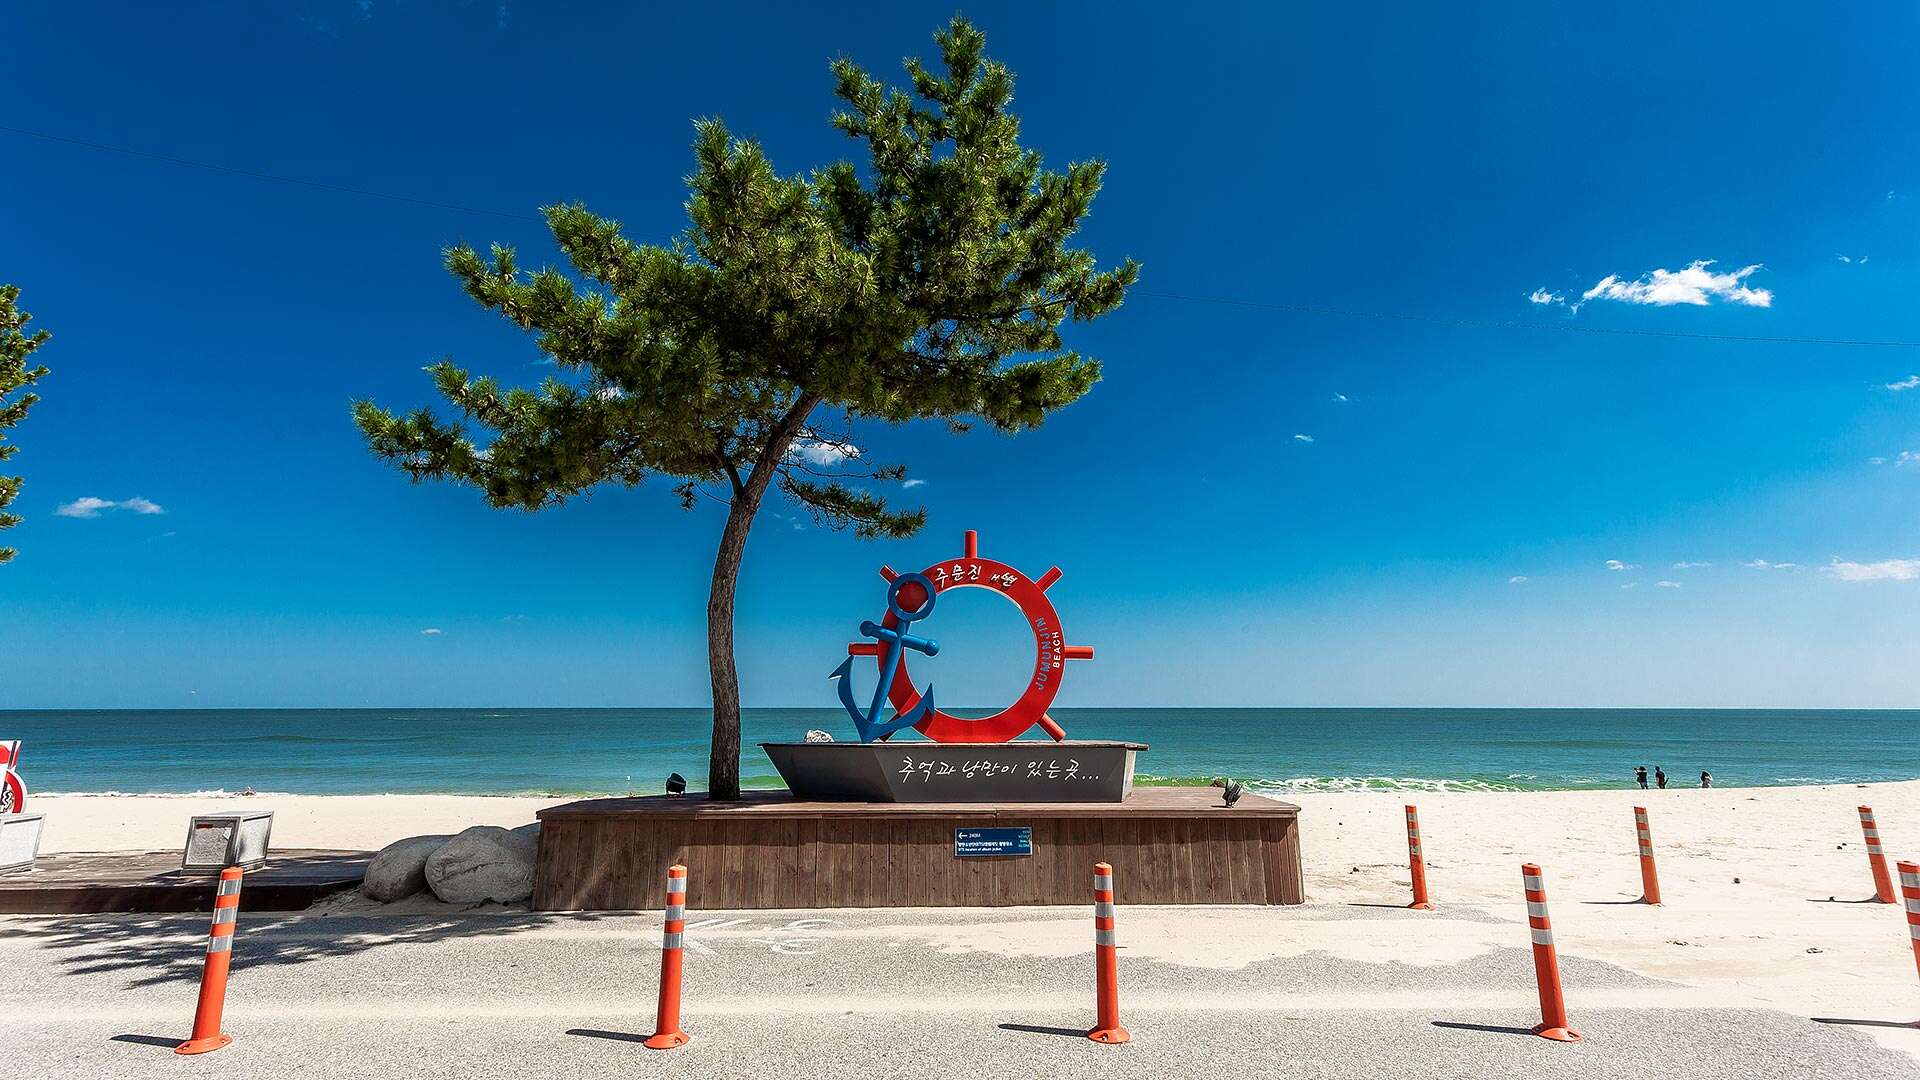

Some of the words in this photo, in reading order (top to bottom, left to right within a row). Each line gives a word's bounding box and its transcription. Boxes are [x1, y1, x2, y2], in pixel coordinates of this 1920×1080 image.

[935, 563, 982, 589] 주문진
[1035, 617, 1051, 691] JUMUNJIN
[1052, 631, 1061, 669] BEACH
[898, 756, 957, 784] 추억과
[962, 759, 1018, 780] 낭만이
[1026, 759, 1061, 780] 있는
